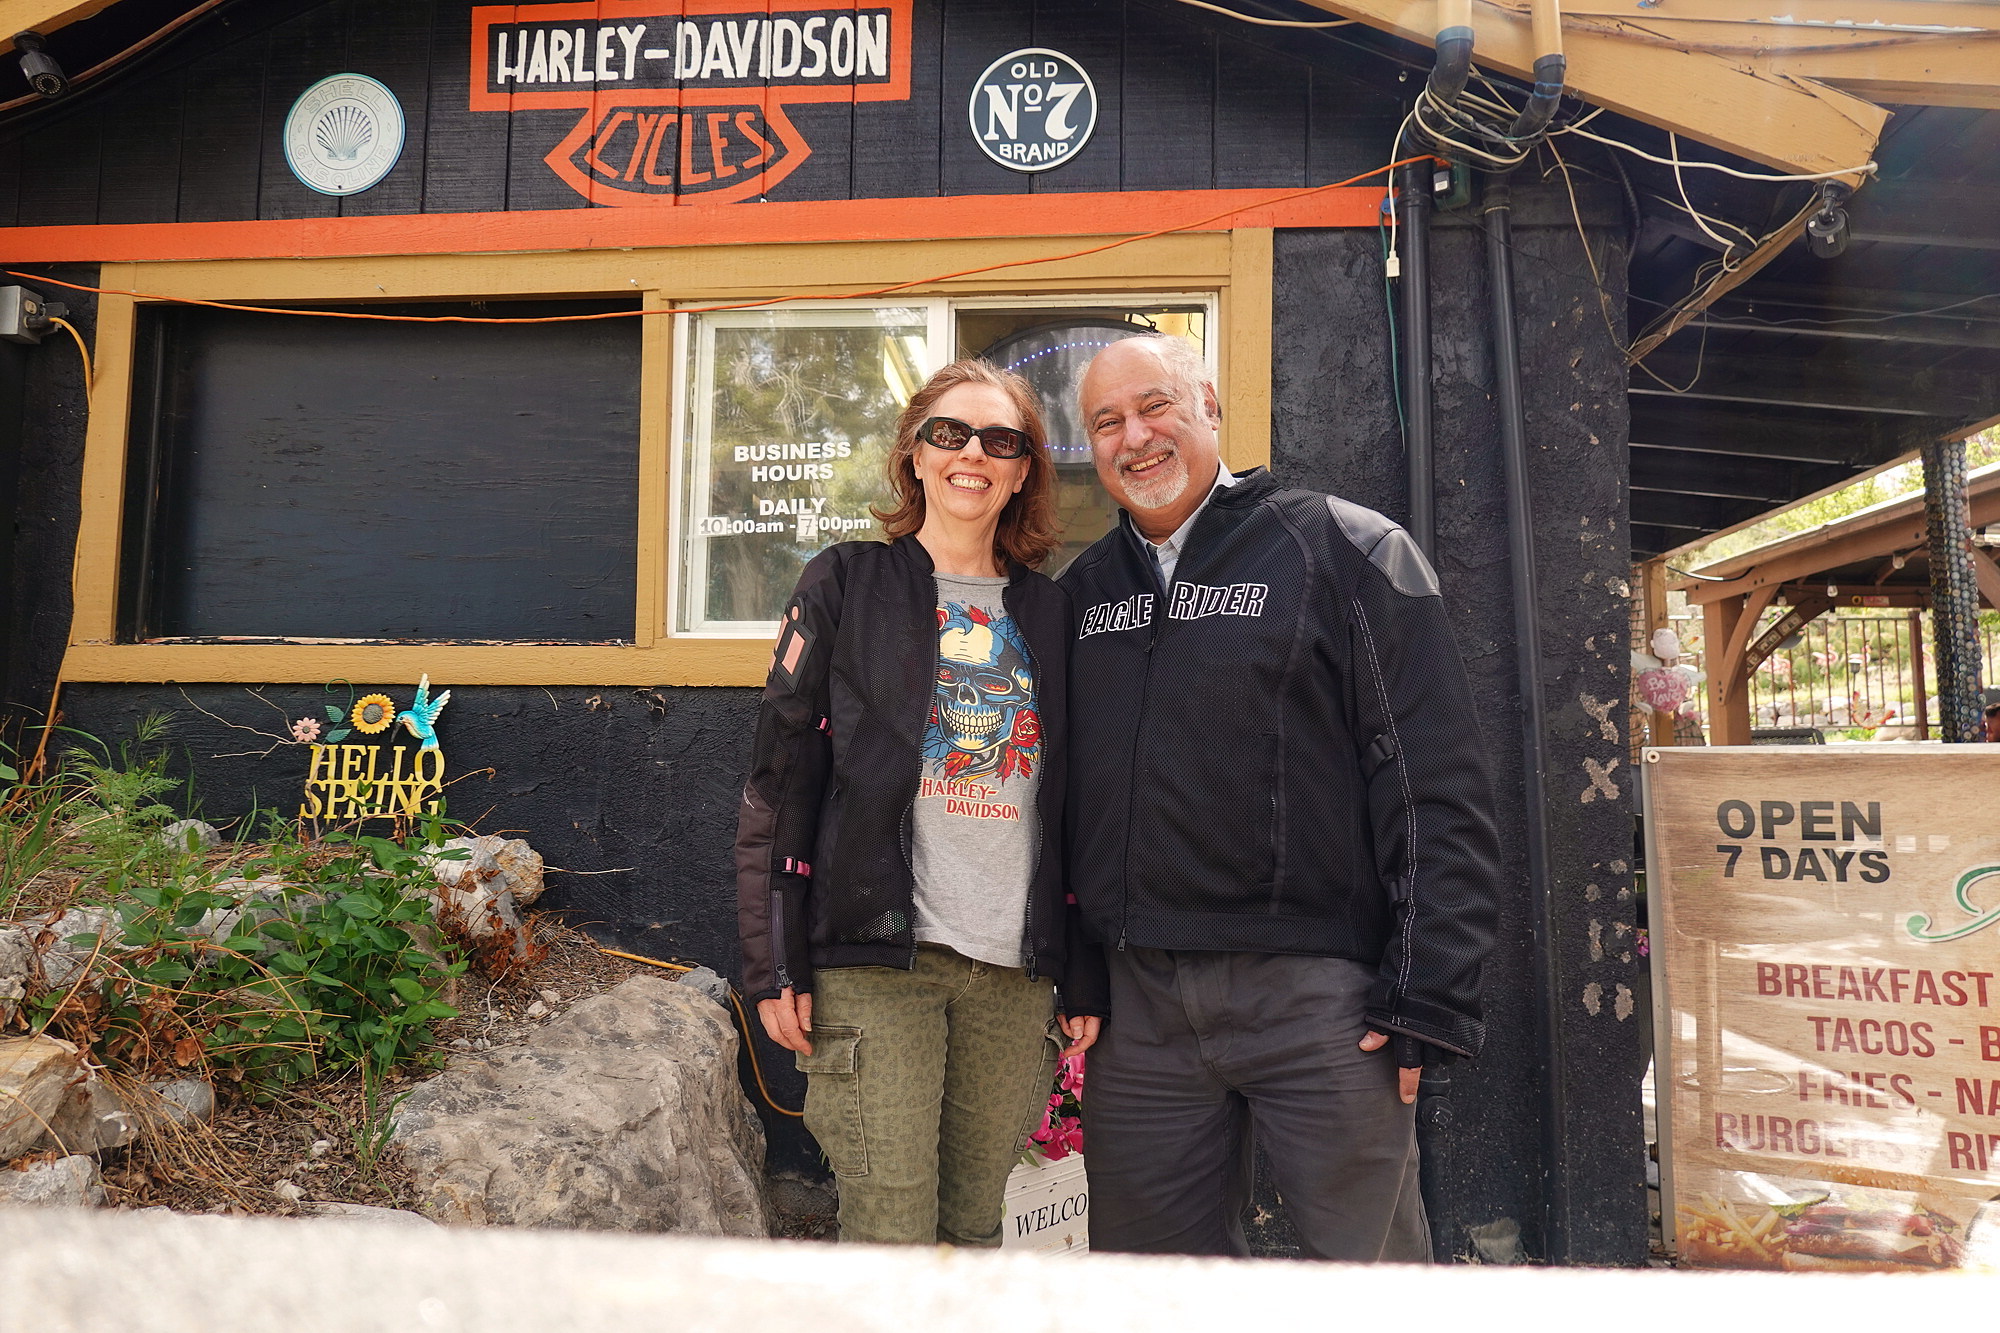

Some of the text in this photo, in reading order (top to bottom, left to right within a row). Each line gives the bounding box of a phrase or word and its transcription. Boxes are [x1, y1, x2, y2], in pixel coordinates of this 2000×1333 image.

[497, 14, 888, 84] HARLEY-DAVIDSON
[1010, 61, 1059, 79] OLD
[304, 81, 384, 114] SHELL
[295, 143, 392, 187] GASOLINE
[584, 111, 775, 186] CYCLES
[999, 142, 1069, 164] BRAND
[734, 441, 851, 462] BUSINESS
[751, 463, 834, 482] HOURS
[759, 497, 827, 516] DAILY
[1078, 581, 1269, 640] EAGLE RIDER
[309, 744, 446, 783] HELLO
[300, 779, 444, 820] SPRING
[920, 776, 998, 801] HARLEY-
[944, 797, 1020, 822] DAVIDSON
[1716, 799, 1882, 842] OPEN
[1716, 844, 1891, 884] 7 DAYS
[1756, 961, 1994, 1008] BREAKFAST
[1806, 1015, 1936, 1058] TACOS
[1798, 1070, 1916, 1110] FRIES
[1947, 1131, 2000, 1171] RI
